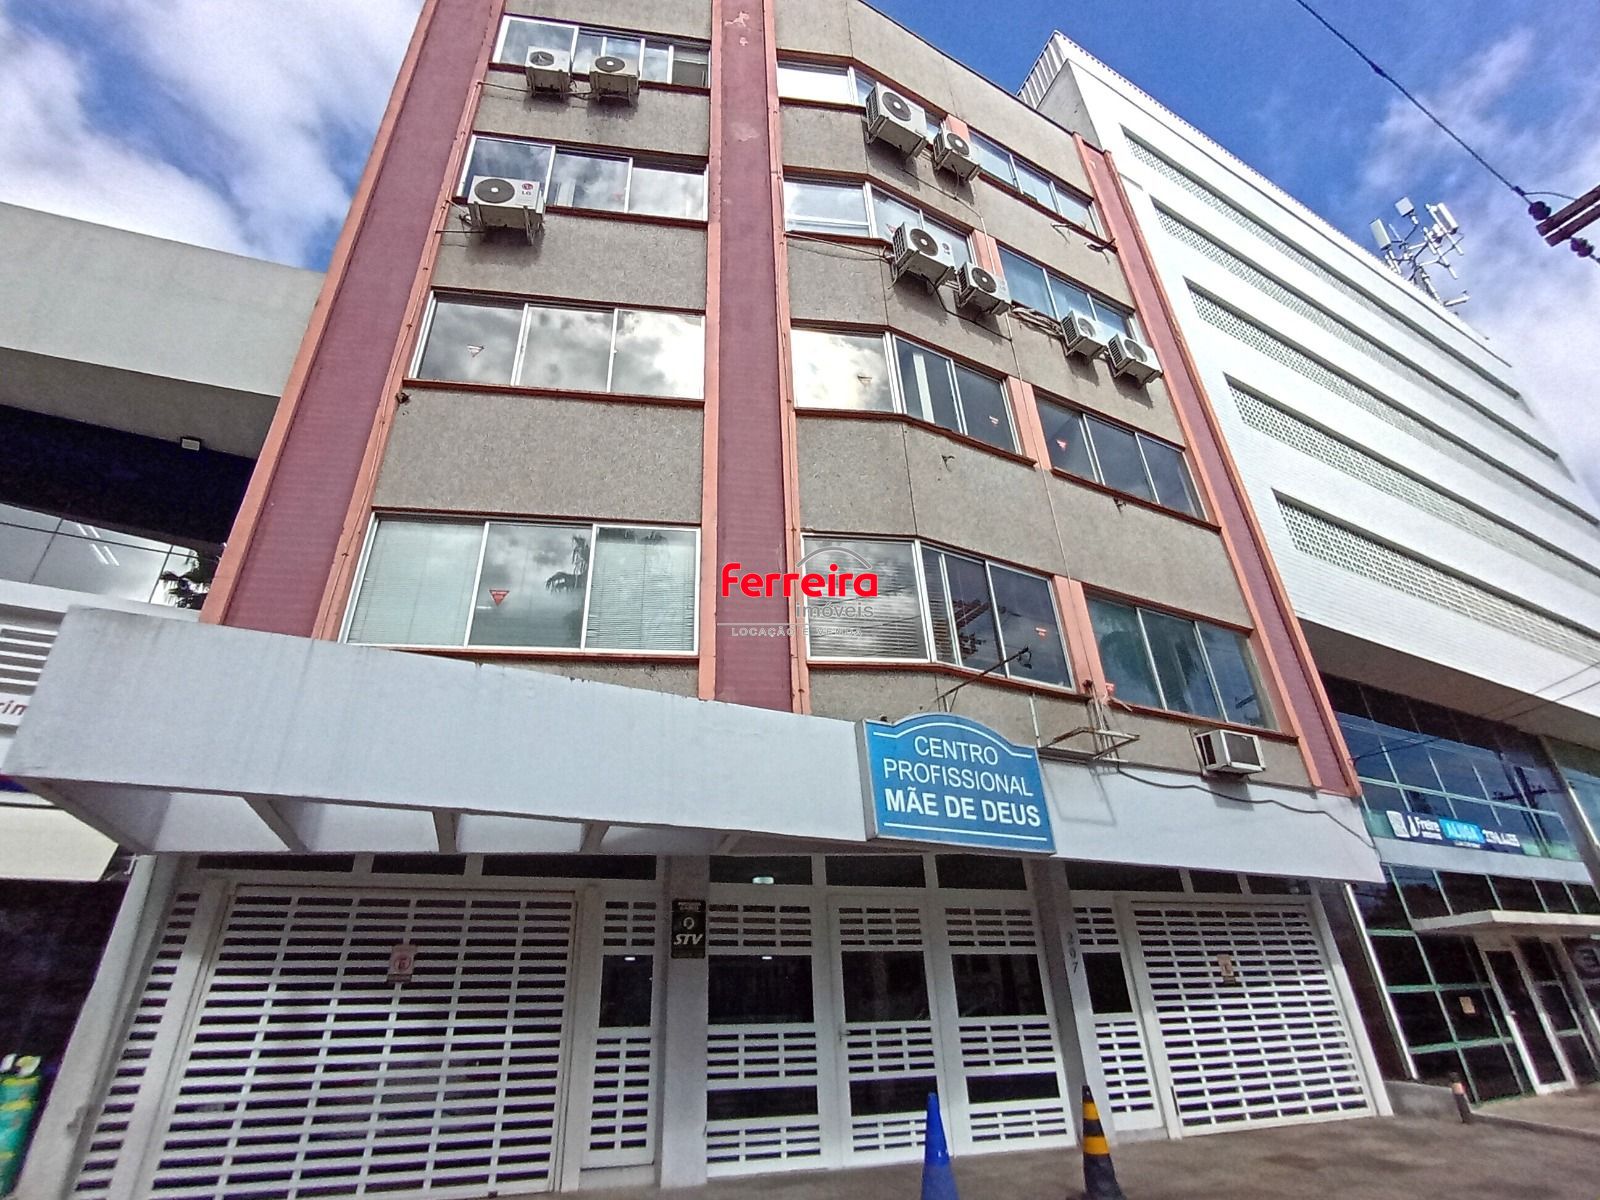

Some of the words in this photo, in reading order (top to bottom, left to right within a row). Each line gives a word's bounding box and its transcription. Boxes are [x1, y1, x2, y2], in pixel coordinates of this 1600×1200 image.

[914, 735, 999, 766] CENTRO
[883, 758, 1034, 797] PROFISSIONAL
[885, 787, 939, 816] MÃE
[944, 795, 977, 820] DE
[981, 799, 1041, 827] DEUS
[673, 933, 703, 945] STV
